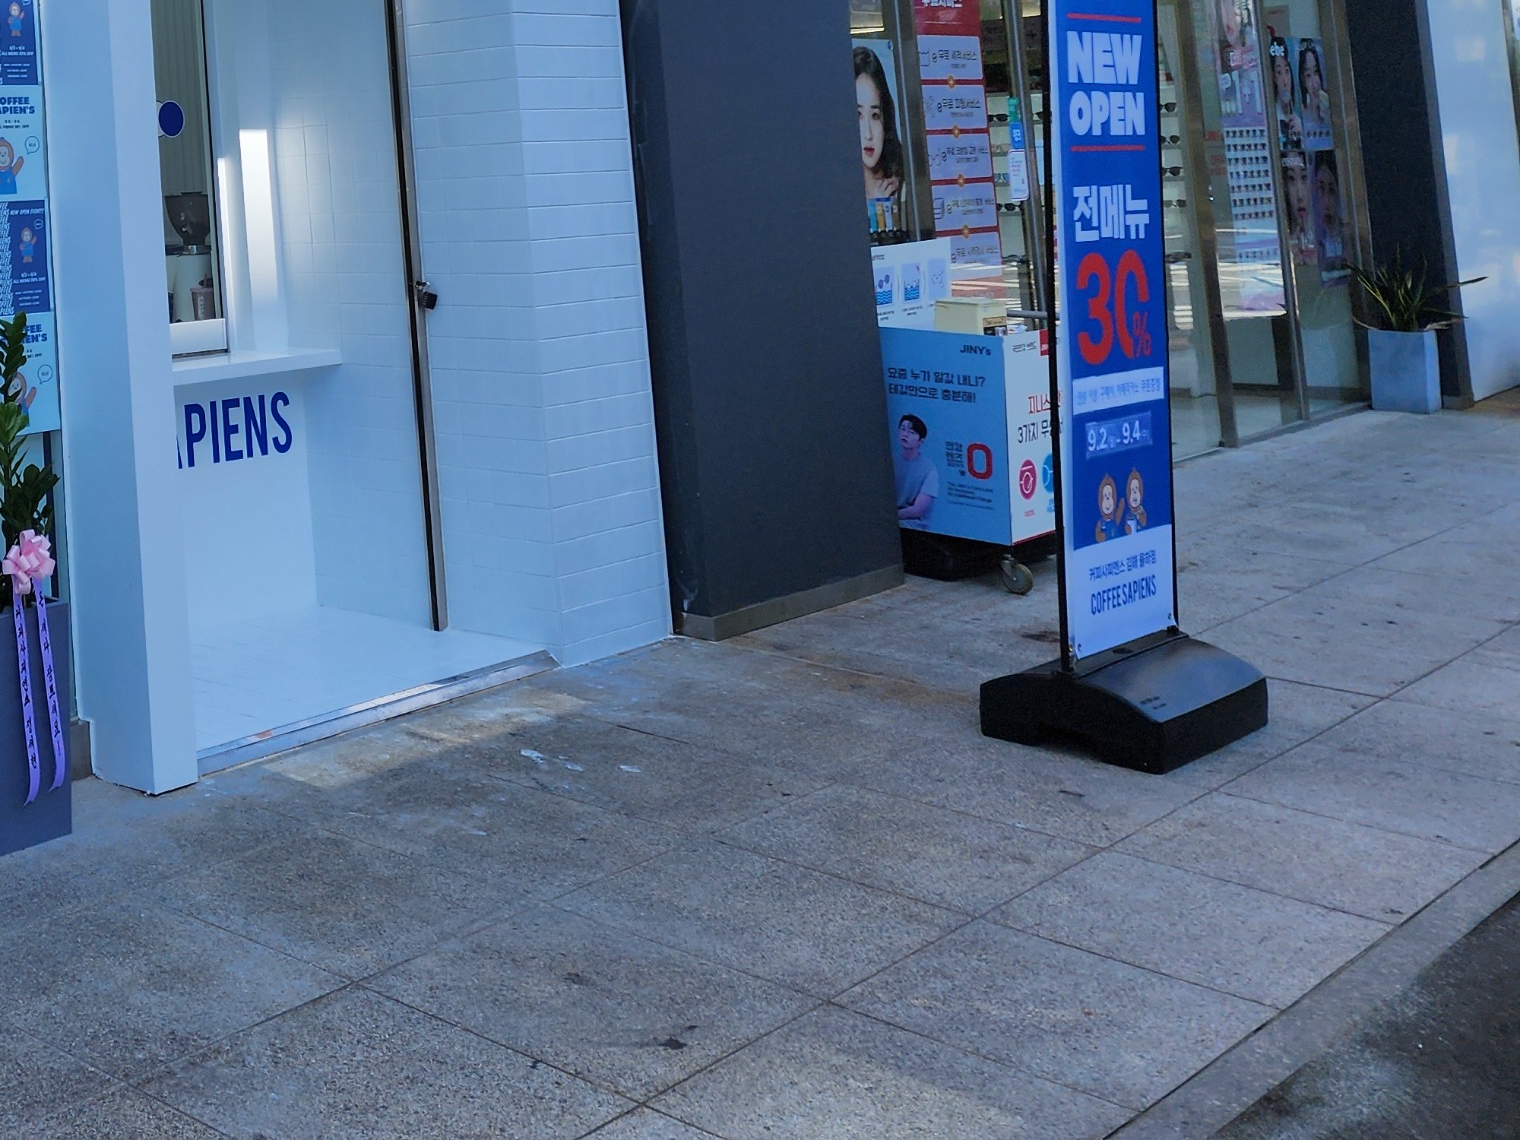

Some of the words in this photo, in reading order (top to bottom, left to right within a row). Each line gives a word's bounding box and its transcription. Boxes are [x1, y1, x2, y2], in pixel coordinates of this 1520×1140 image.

[1066, 30, 1143, 86] NEW
[1069, 90, 1146, 137] OPEN
[1072, 183, 1150, 243] 전메뉴
[1075, 248, 1152, 366] 30%
[960, 344, 992, 357] JINY's
[887, 367, 908, 380] 요즘
[910, 369, 931, 383] 누가
[1090, 585, 1122, 616] COFFEE
[1122, 574, 1157, 606] SAPIENS
